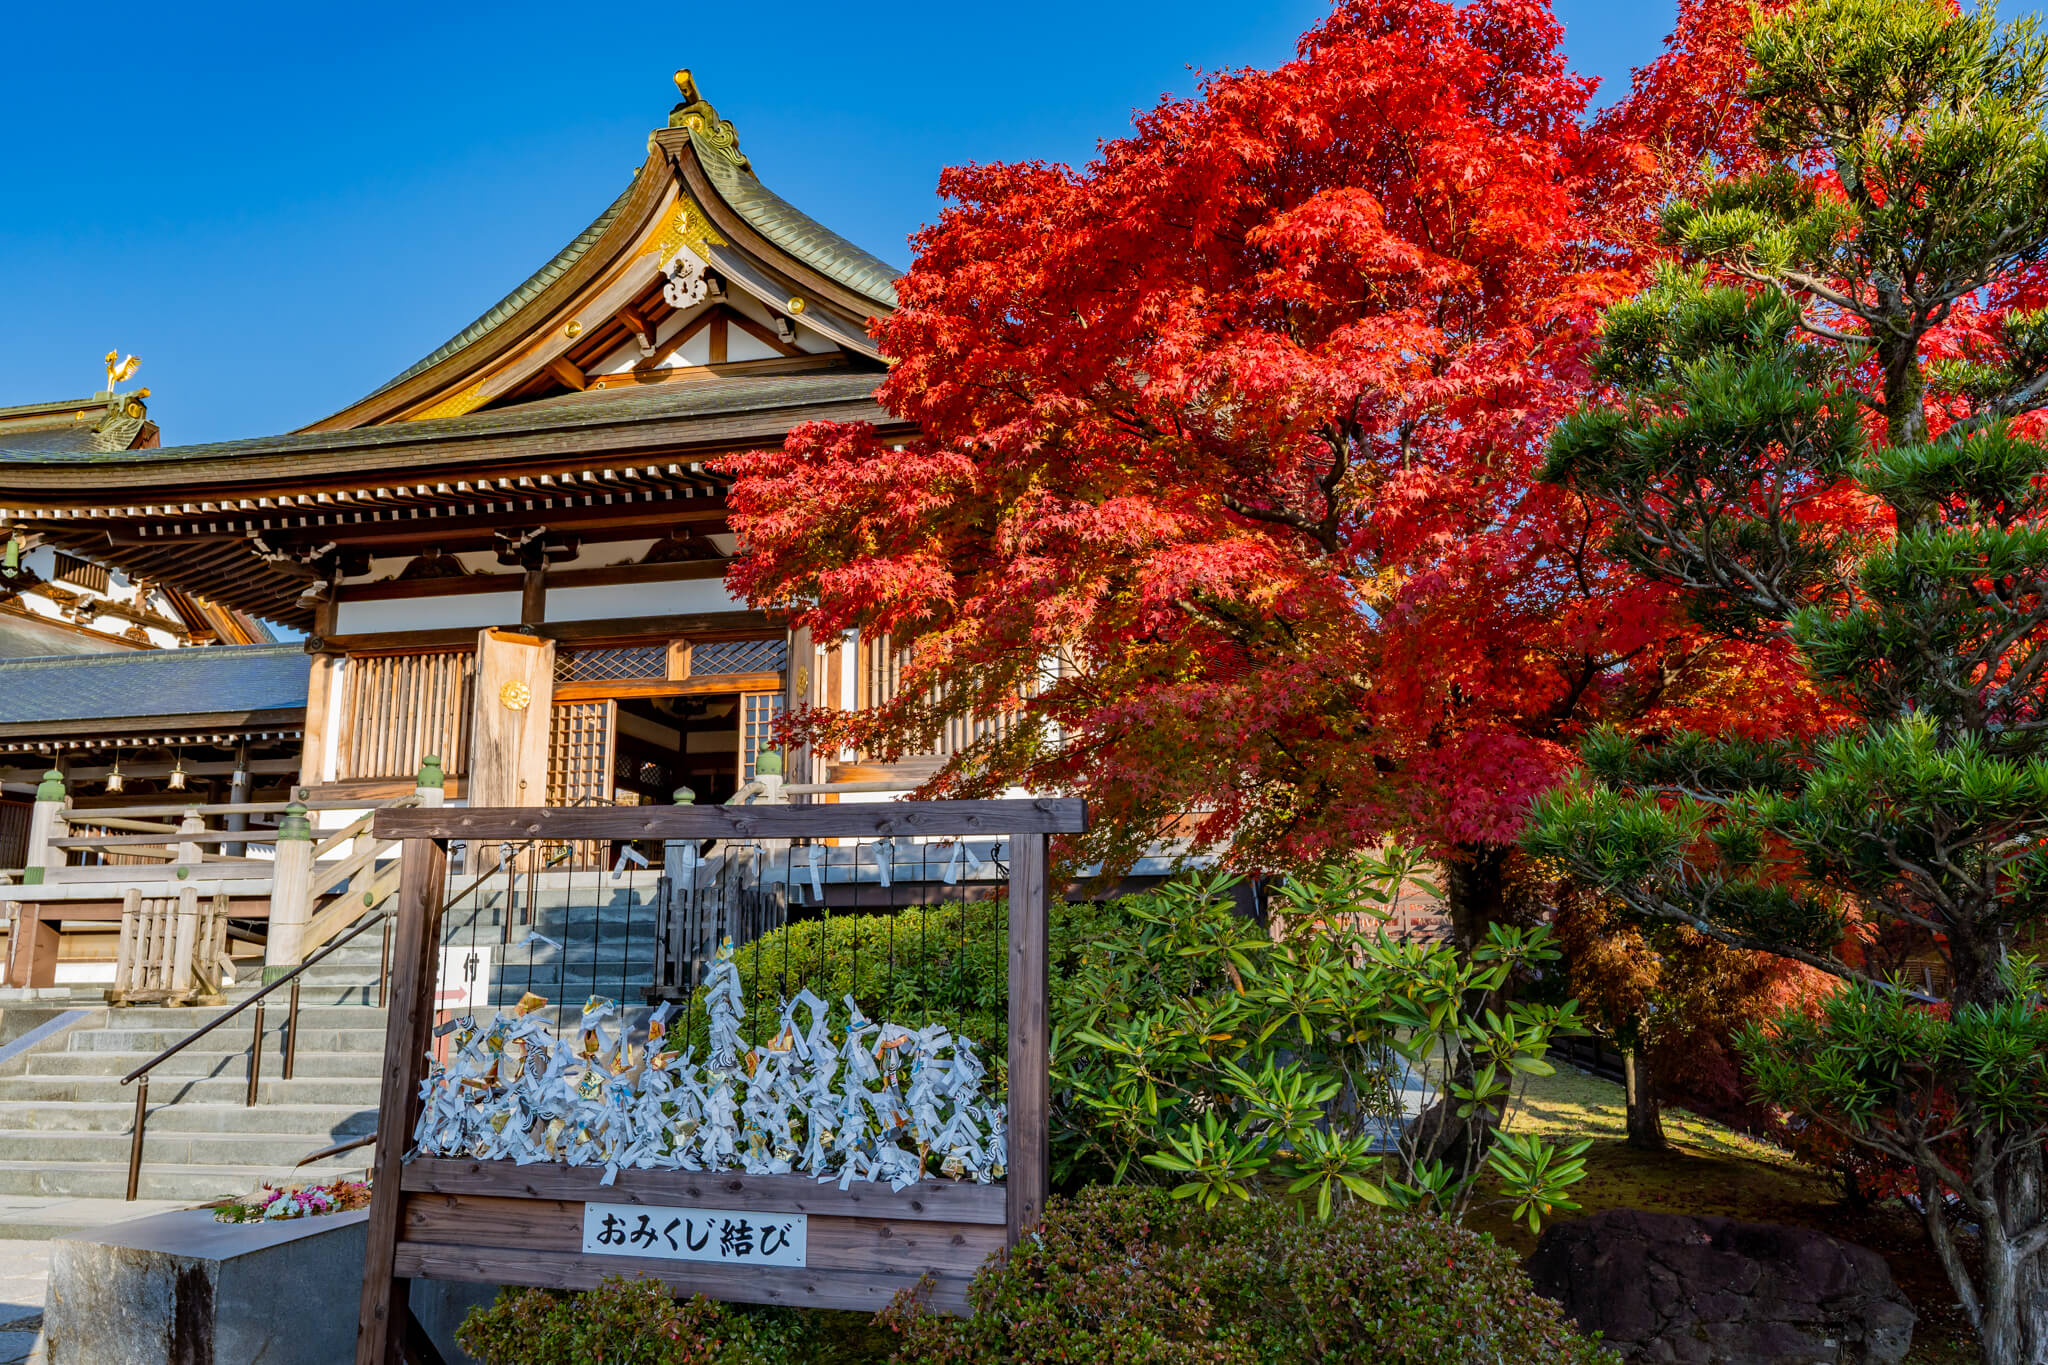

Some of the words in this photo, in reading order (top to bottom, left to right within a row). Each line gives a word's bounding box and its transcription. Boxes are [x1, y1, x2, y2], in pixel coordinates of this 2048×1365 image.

[597, 1213, 792, 1258] おみくじ結び
